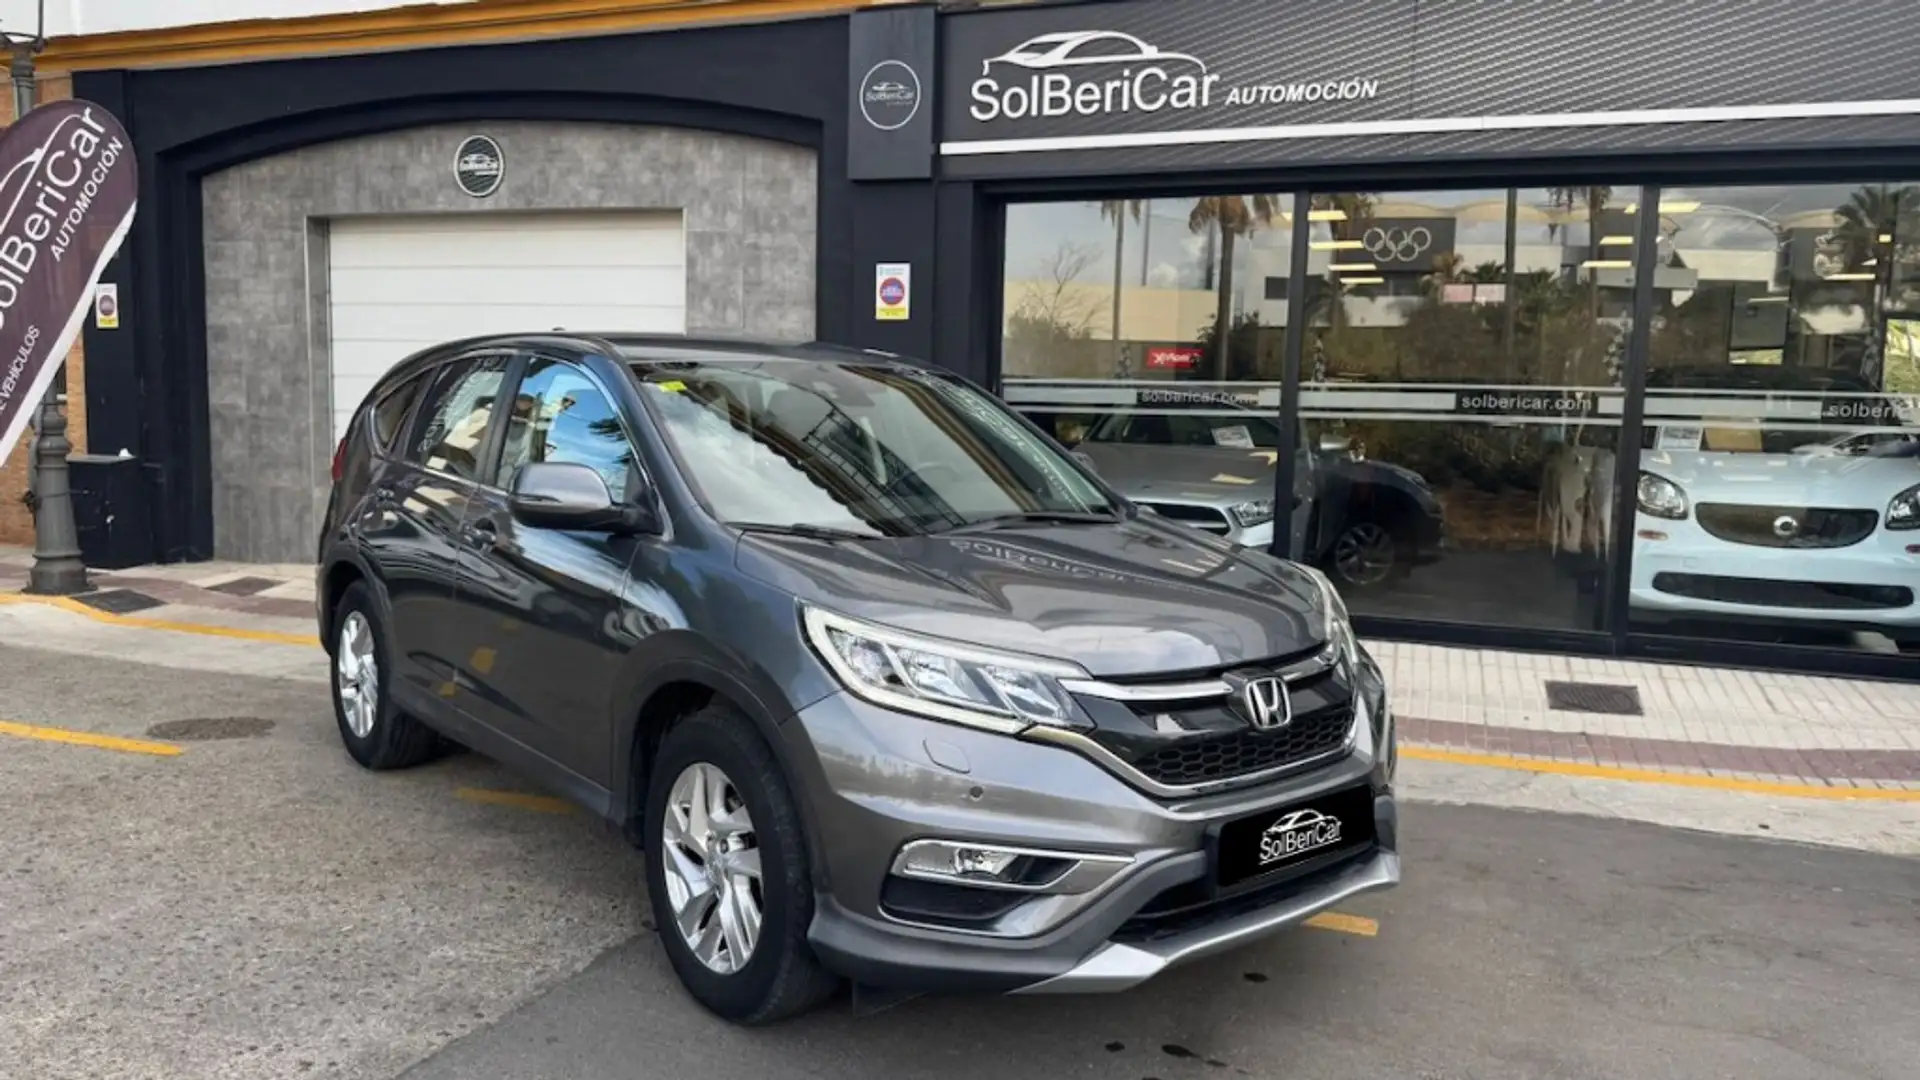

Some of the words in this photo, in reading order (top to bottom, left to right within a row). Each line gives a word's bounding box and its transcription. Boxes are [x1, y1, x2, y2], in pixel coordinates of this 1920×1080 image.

[969, 67, 1220, 121] SolBeriCar
[1224, 76, 1379, 106] AUTOMOCIÓN
[0, 107, 106, 330] olBeriCar
[51, 136, 124, 262] AUTOMOCIÓN
[1461, 393, 1592, 410] solbericar.com
[1259, 820, 1342, 861] SolBeriCar
